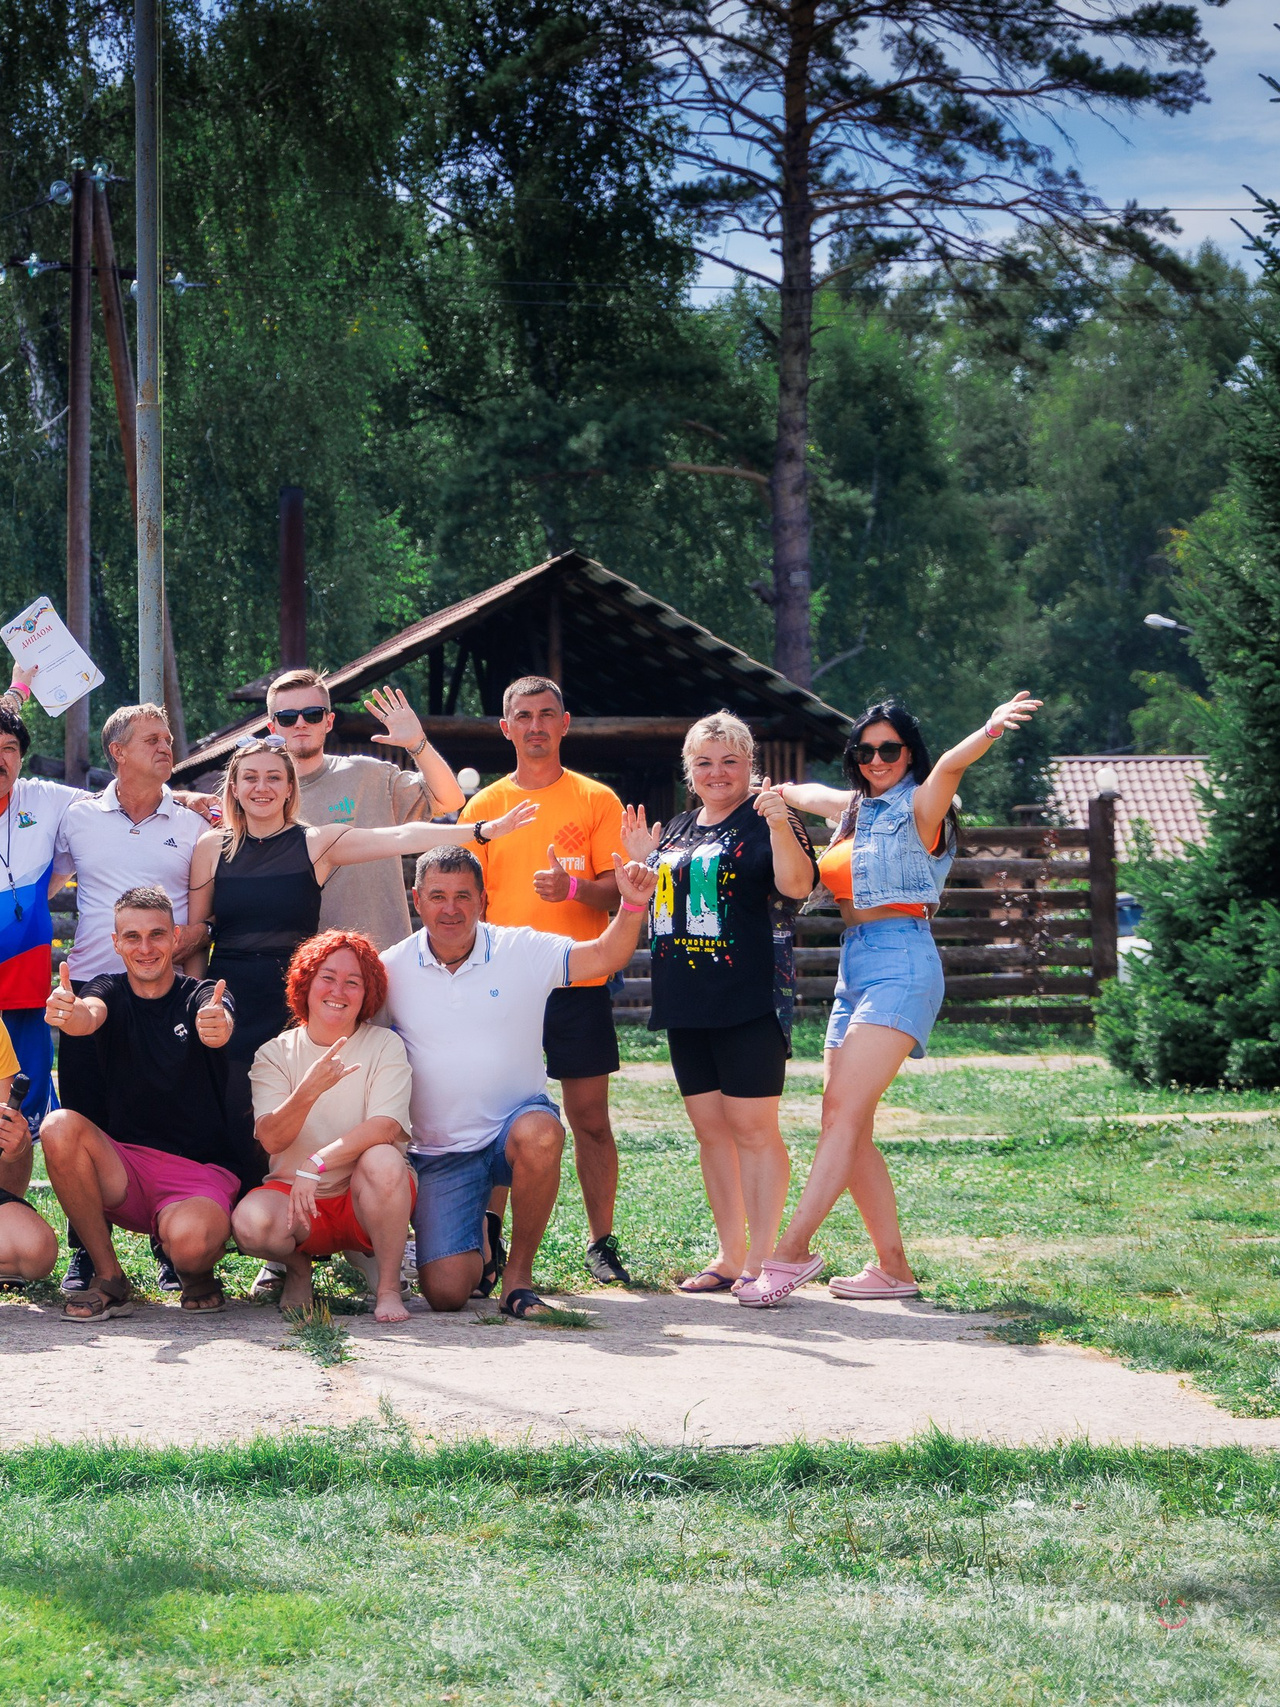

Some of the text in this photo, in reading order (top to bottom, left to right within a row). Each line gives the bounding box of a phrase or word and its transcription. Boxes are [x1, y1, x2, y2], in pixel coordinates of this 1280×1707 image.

[22, 625, 53, 650] ДИПЛОМ
[673, 938, 728, 948] WONDERFUL
[761, 1281, 795, 1303] crocs
